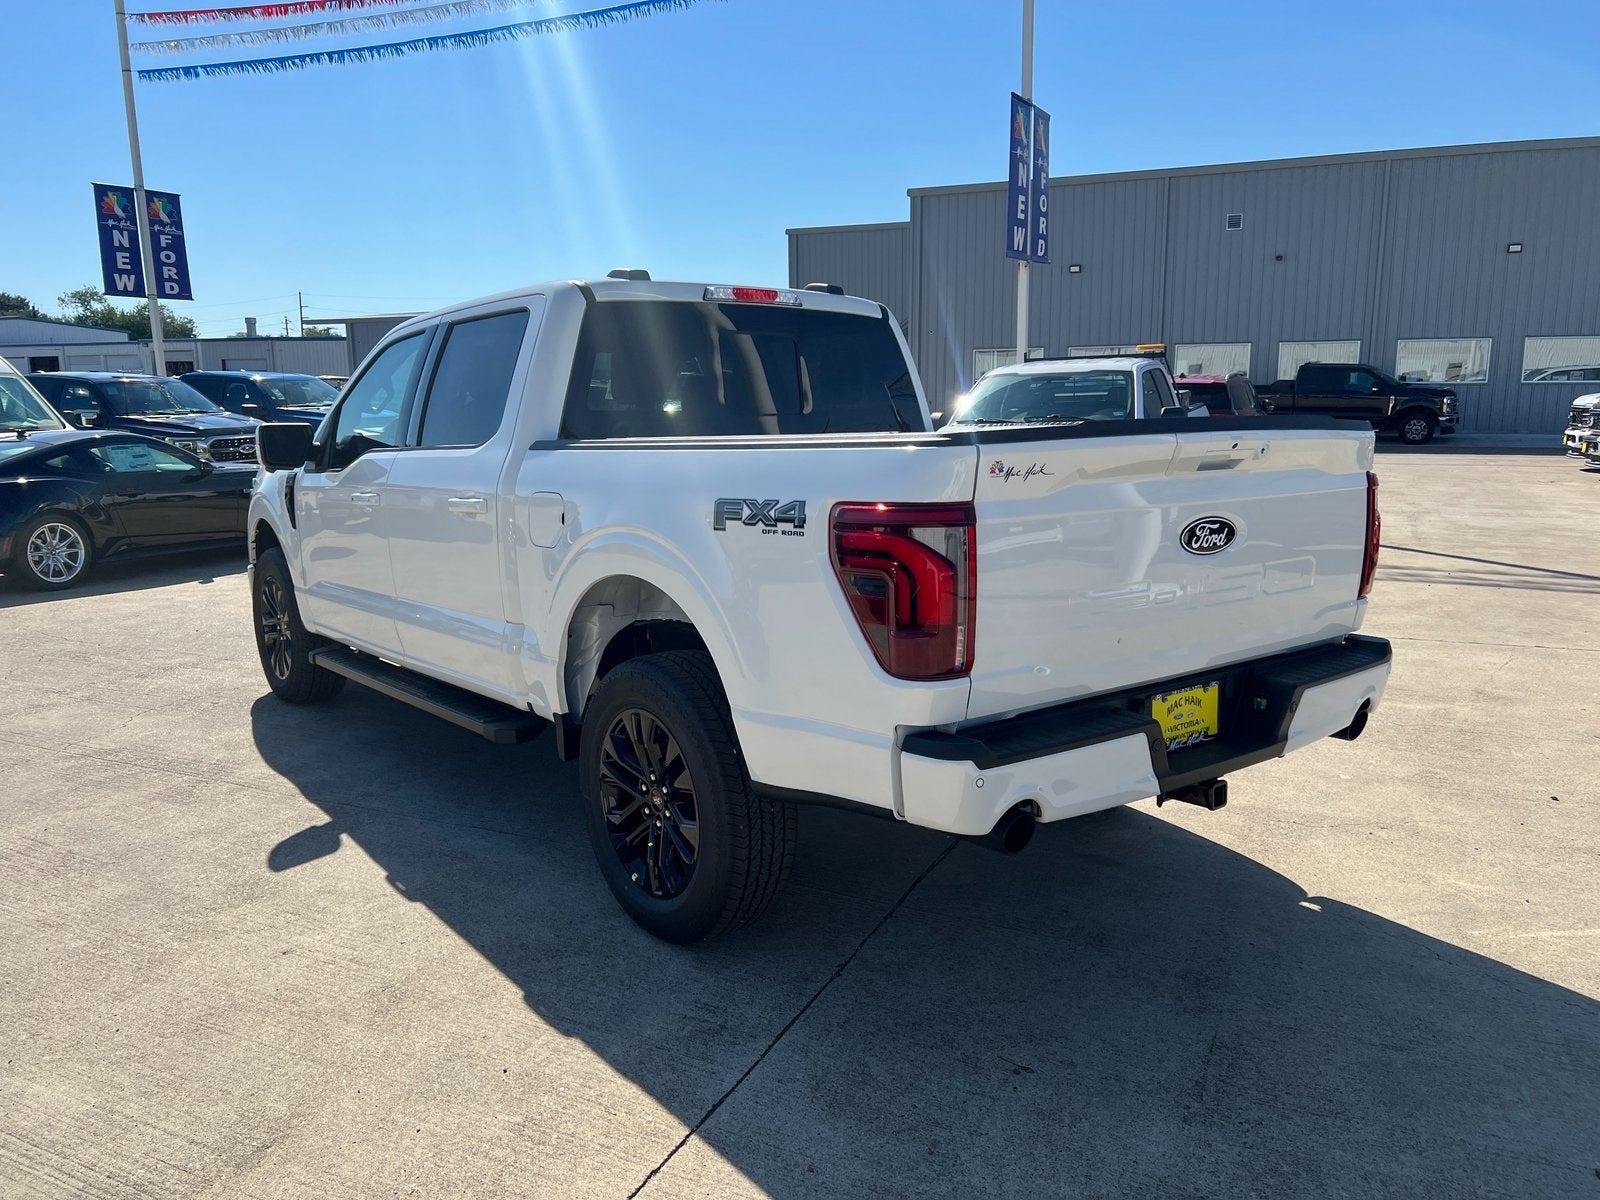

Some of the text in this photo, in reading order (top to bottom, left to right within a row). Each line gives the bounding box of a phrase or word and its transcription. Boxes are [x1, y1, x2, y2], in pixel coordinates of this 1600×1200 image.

[1013, 162, 1027, 251] NEW
[1037, 171, 1048, 257] FORD
[112, 229, 135, 291] NEW
[159, 234, 180, 294] FORD
[1003, 466, 1022, 483] Mac
[713, 498, 806, 531] FX4
[761, 528, 805, 537] OFF ROAD
[1191, 523, 1228, 549] Ford
[1166, 697, 1183, 717] MAC
[1184, 695, 1203, 709] HAIK
